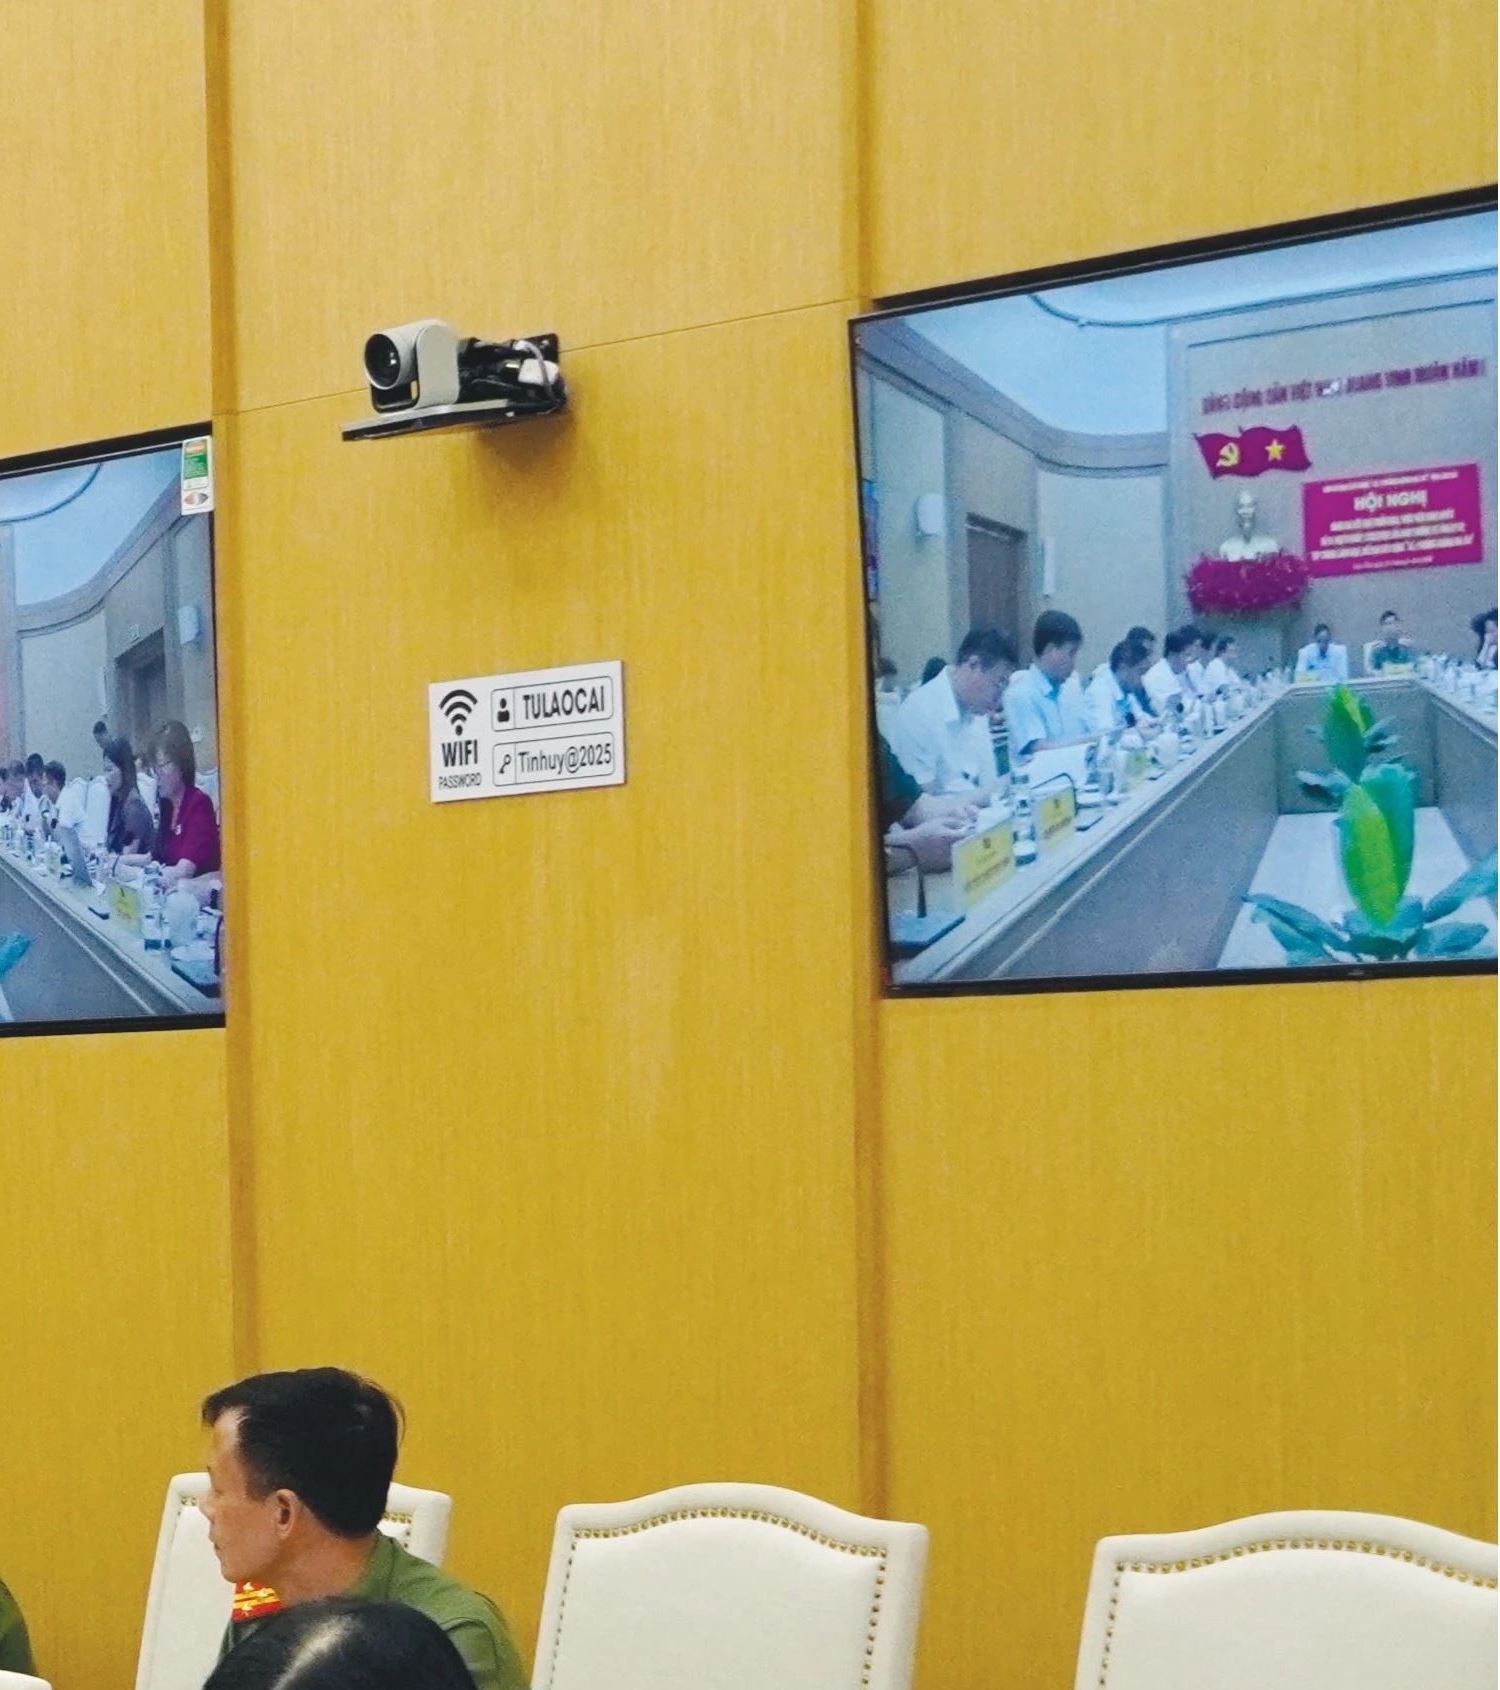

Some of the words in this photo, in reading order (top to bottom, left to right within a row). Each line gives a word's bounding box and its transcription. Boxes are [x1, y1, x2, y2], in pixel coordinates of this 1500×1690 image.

[523, 686, 604, 720] TULAOCAI
[441, 739, 478, 767] WIFI
[518, 743, 612, 774] Tinhuy@2025
[439, 772, 481, 789] PASSWORD
